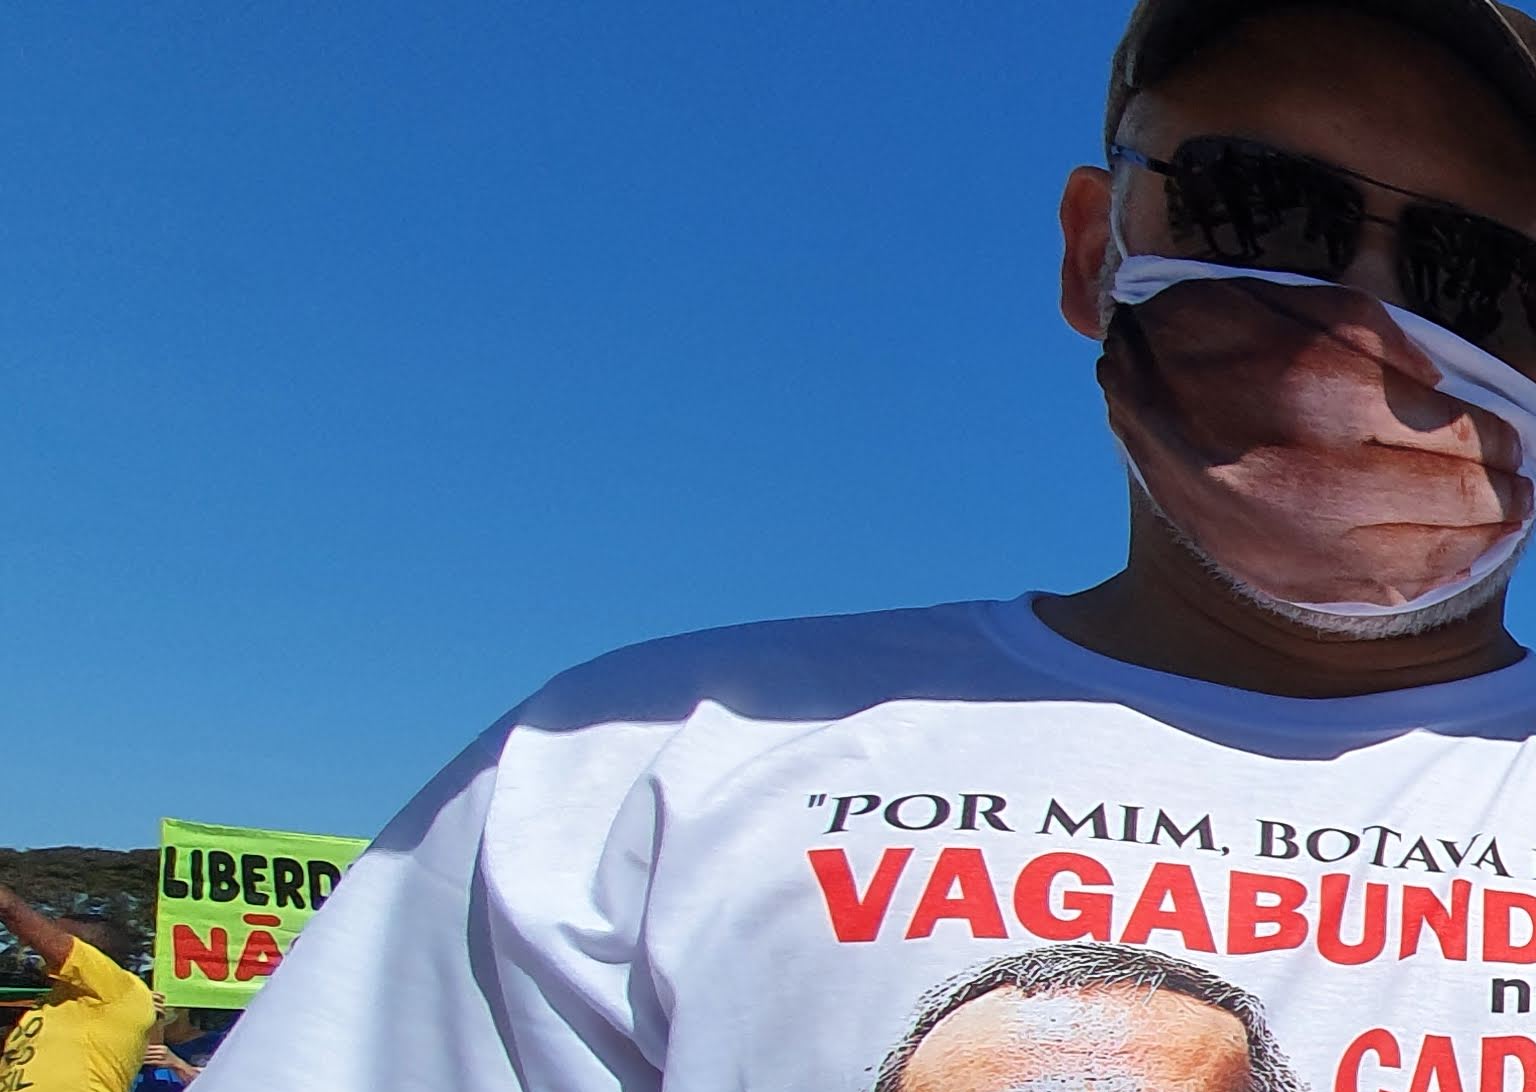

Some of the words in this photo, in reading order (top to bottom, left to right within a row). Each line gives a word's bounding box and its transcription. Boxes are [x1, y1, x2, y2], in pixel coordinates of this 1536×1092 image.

[807, 793, 1016, 835] "POR
[1036, 798, 1230, 856] MIM,
[1256, 818, 1514, 878] BOTAVA
[163, 846, 353, 911] LIBERD
[172, 914, 301, 981] NÃ
